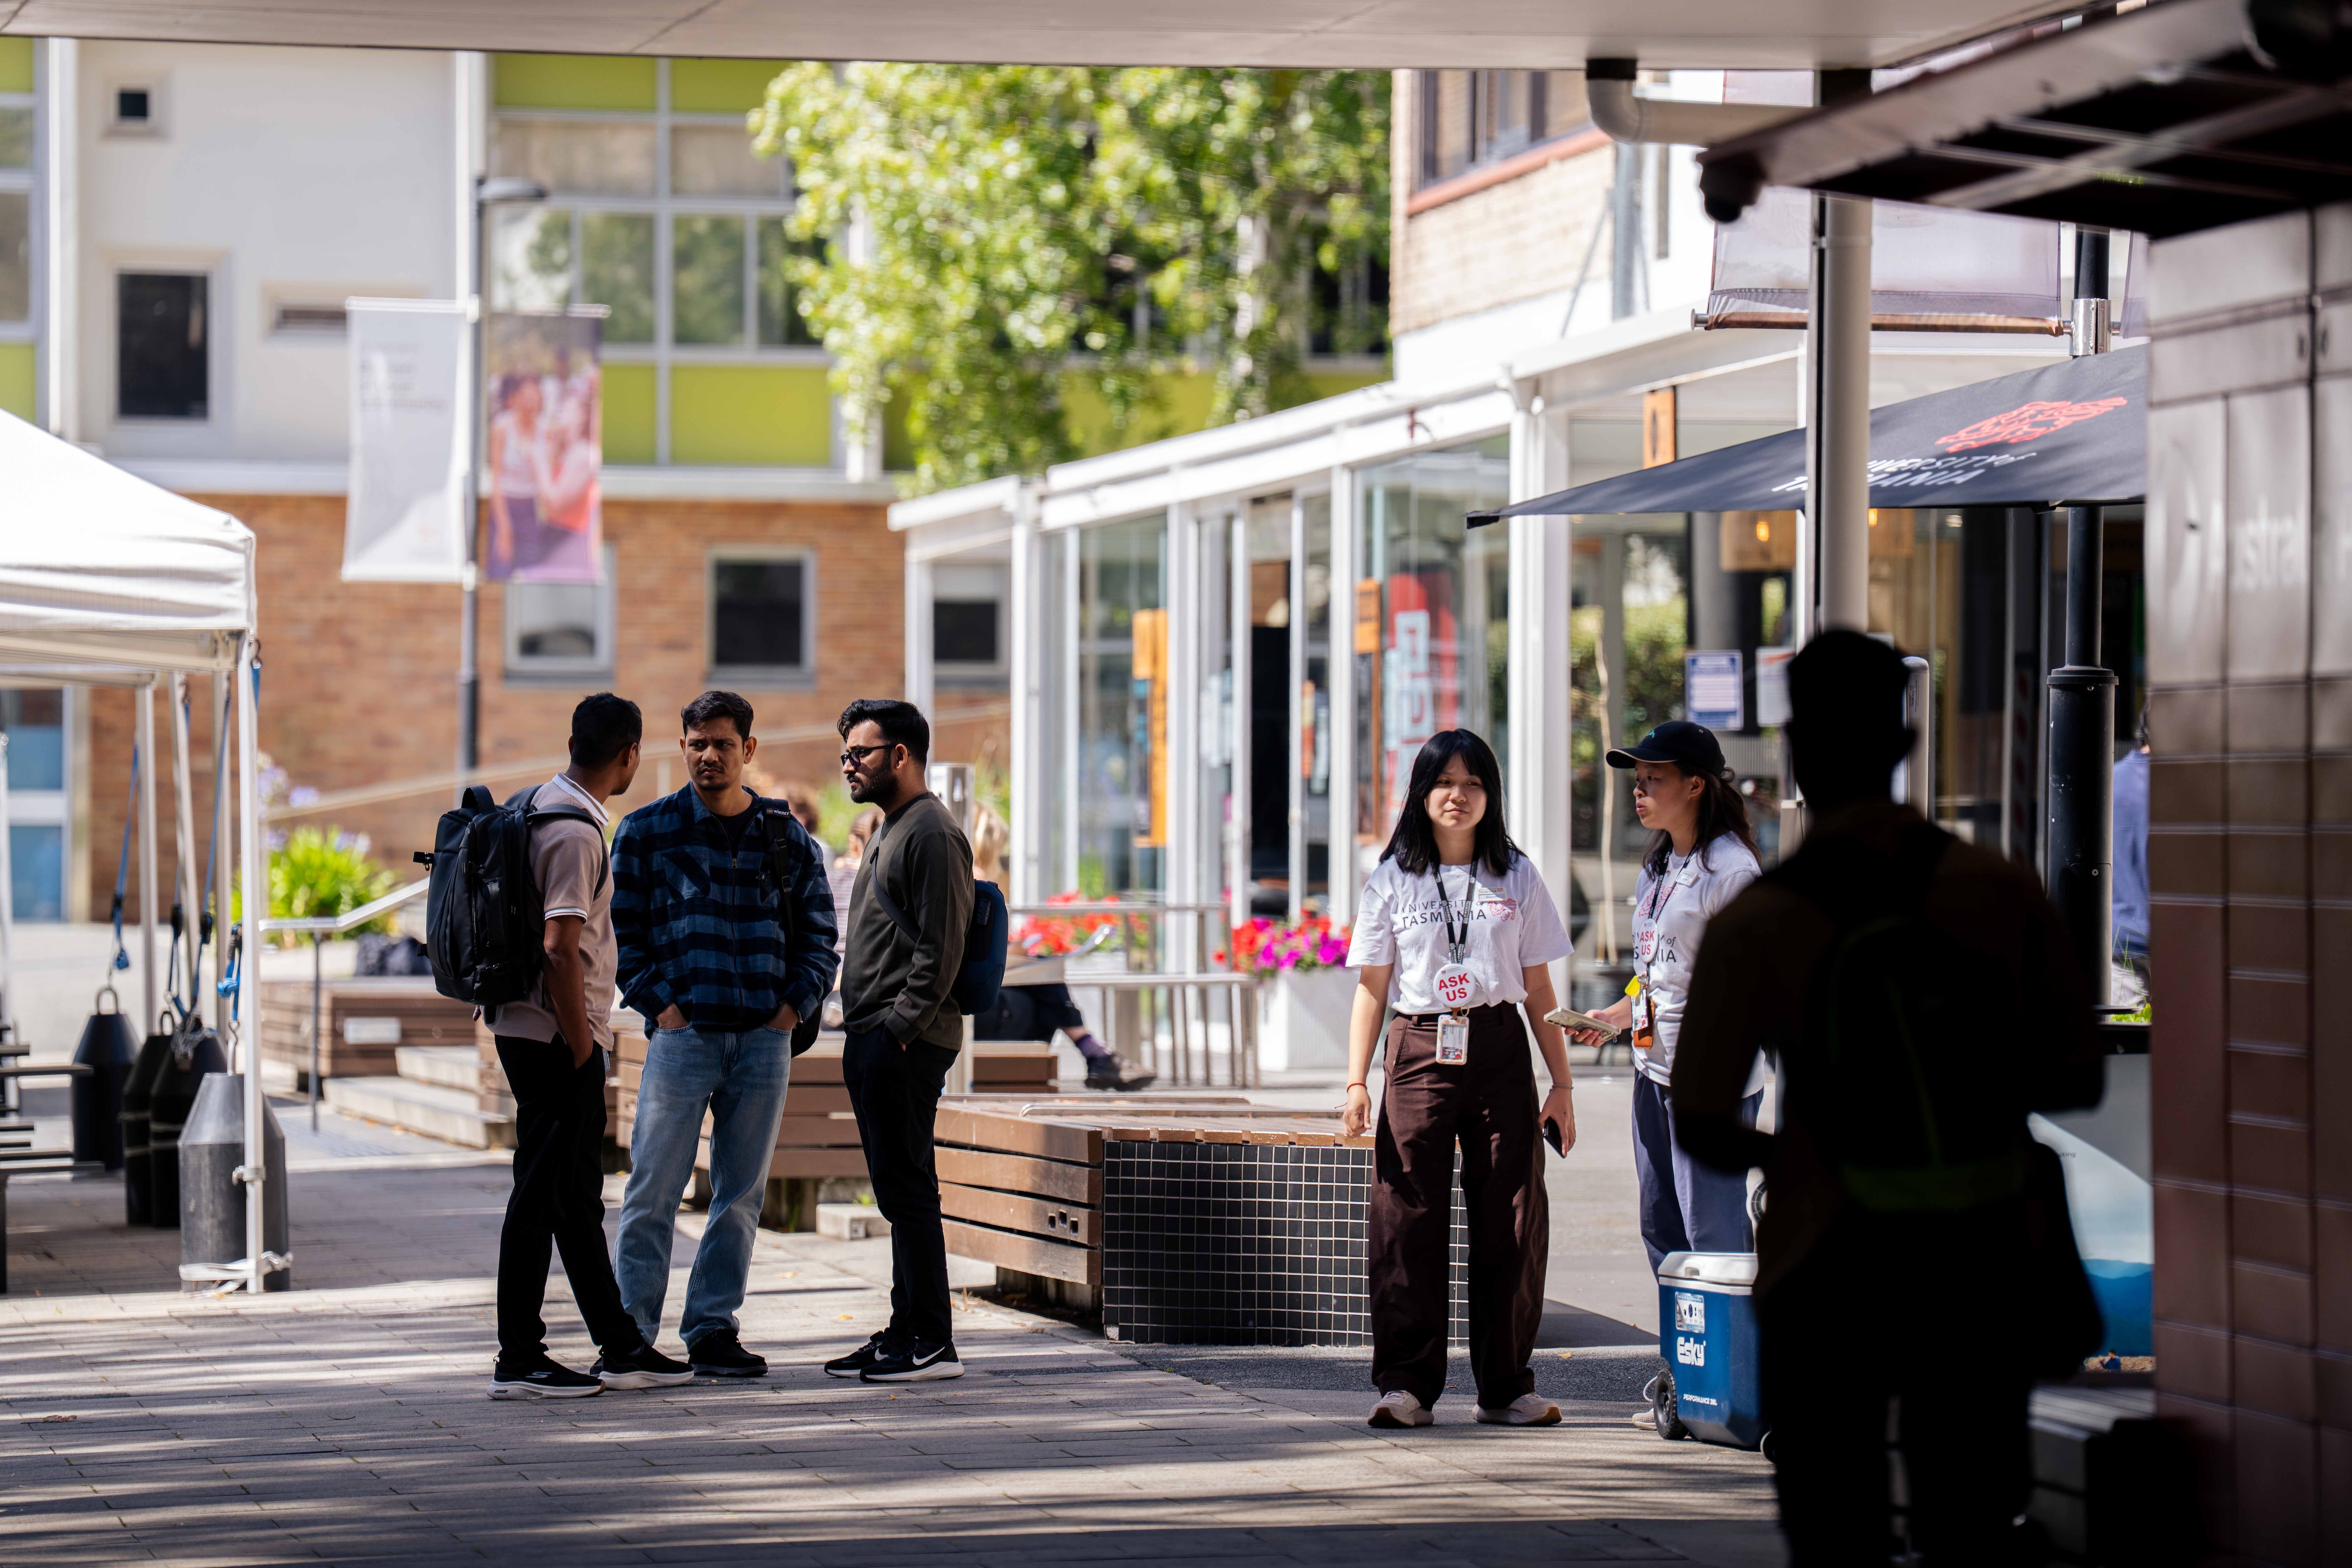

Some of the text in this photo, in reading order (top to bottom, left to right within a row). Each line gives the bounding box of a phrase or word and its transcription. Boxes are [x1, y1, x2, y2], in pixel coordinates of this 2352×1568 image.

[1867, 455, 2010, 472] IVERSITY
[1771, 469, 1986, 491] TAANIA
[1402, 899, 1474, 913] NIVESIT
[1639, 931, 1655, 942] ASK
[1666, 937, 1677, 947] of
[1641, 944, 1651, 955] US
[1438, 972, 1470, 990] ASK
[1446, 987, 1467, 1001] US
[1677, 1337, 1705, 1367] Esky
[1683, 1394, 1710, 1404] PERFORMANCE
